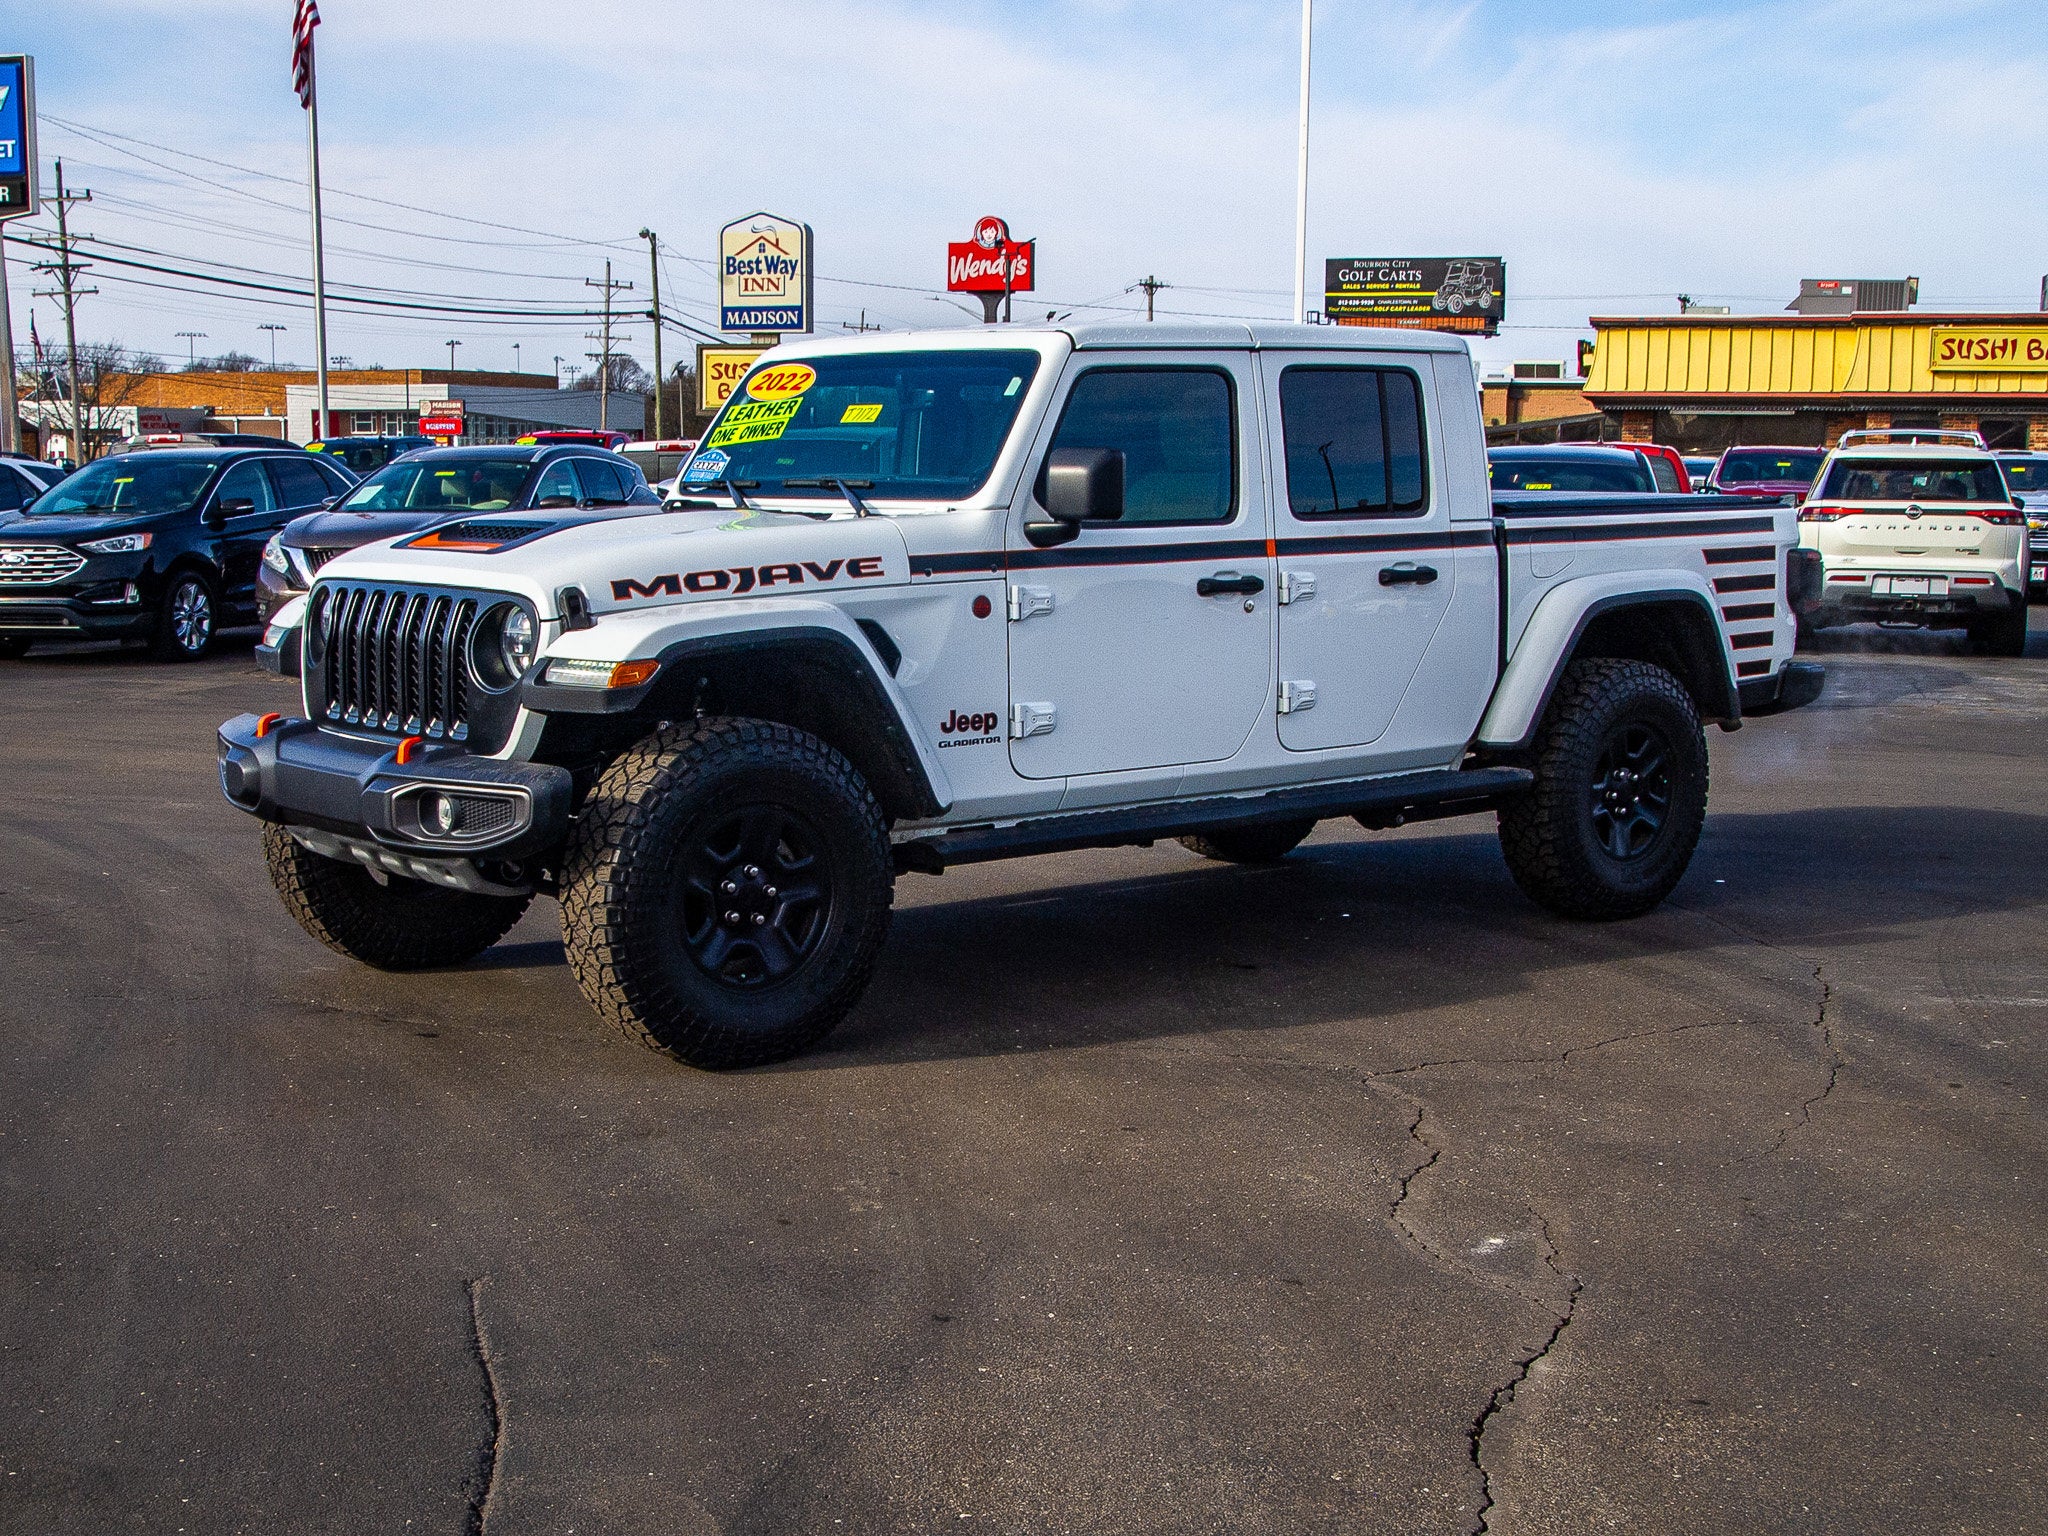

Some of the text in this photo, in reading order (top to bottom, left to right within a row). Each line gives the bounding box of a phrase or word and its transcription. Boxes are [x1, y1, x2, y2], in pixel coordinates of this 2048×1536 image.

[725, 255, 799, 281] Best Way
[950, 248, 1028, 284] Wendy's
[1353, 260, 1411, 269] BOURBON CITY
[742, 277, 781, 292] INN
[1338, 268, 1422, 282] GOLF CARTS
[1395, 282, 1421, 290] RENTALS
[725, 310, 799, 326] MADISON
[1940, 337, 2048, 361] SUSHI B
[751, 372, 812, 392] 2022
[723, 400, 799, 424] LEATHER
[711, 421, 785, 445] ONE OWNER
[1847, 524, 1981, 533] PATHFINDER
[610, 556, 885, 601] MOJAVE
[940, 709, 999, 736] Jeep
[938, 735, 1002, 749] GLADIATOR
